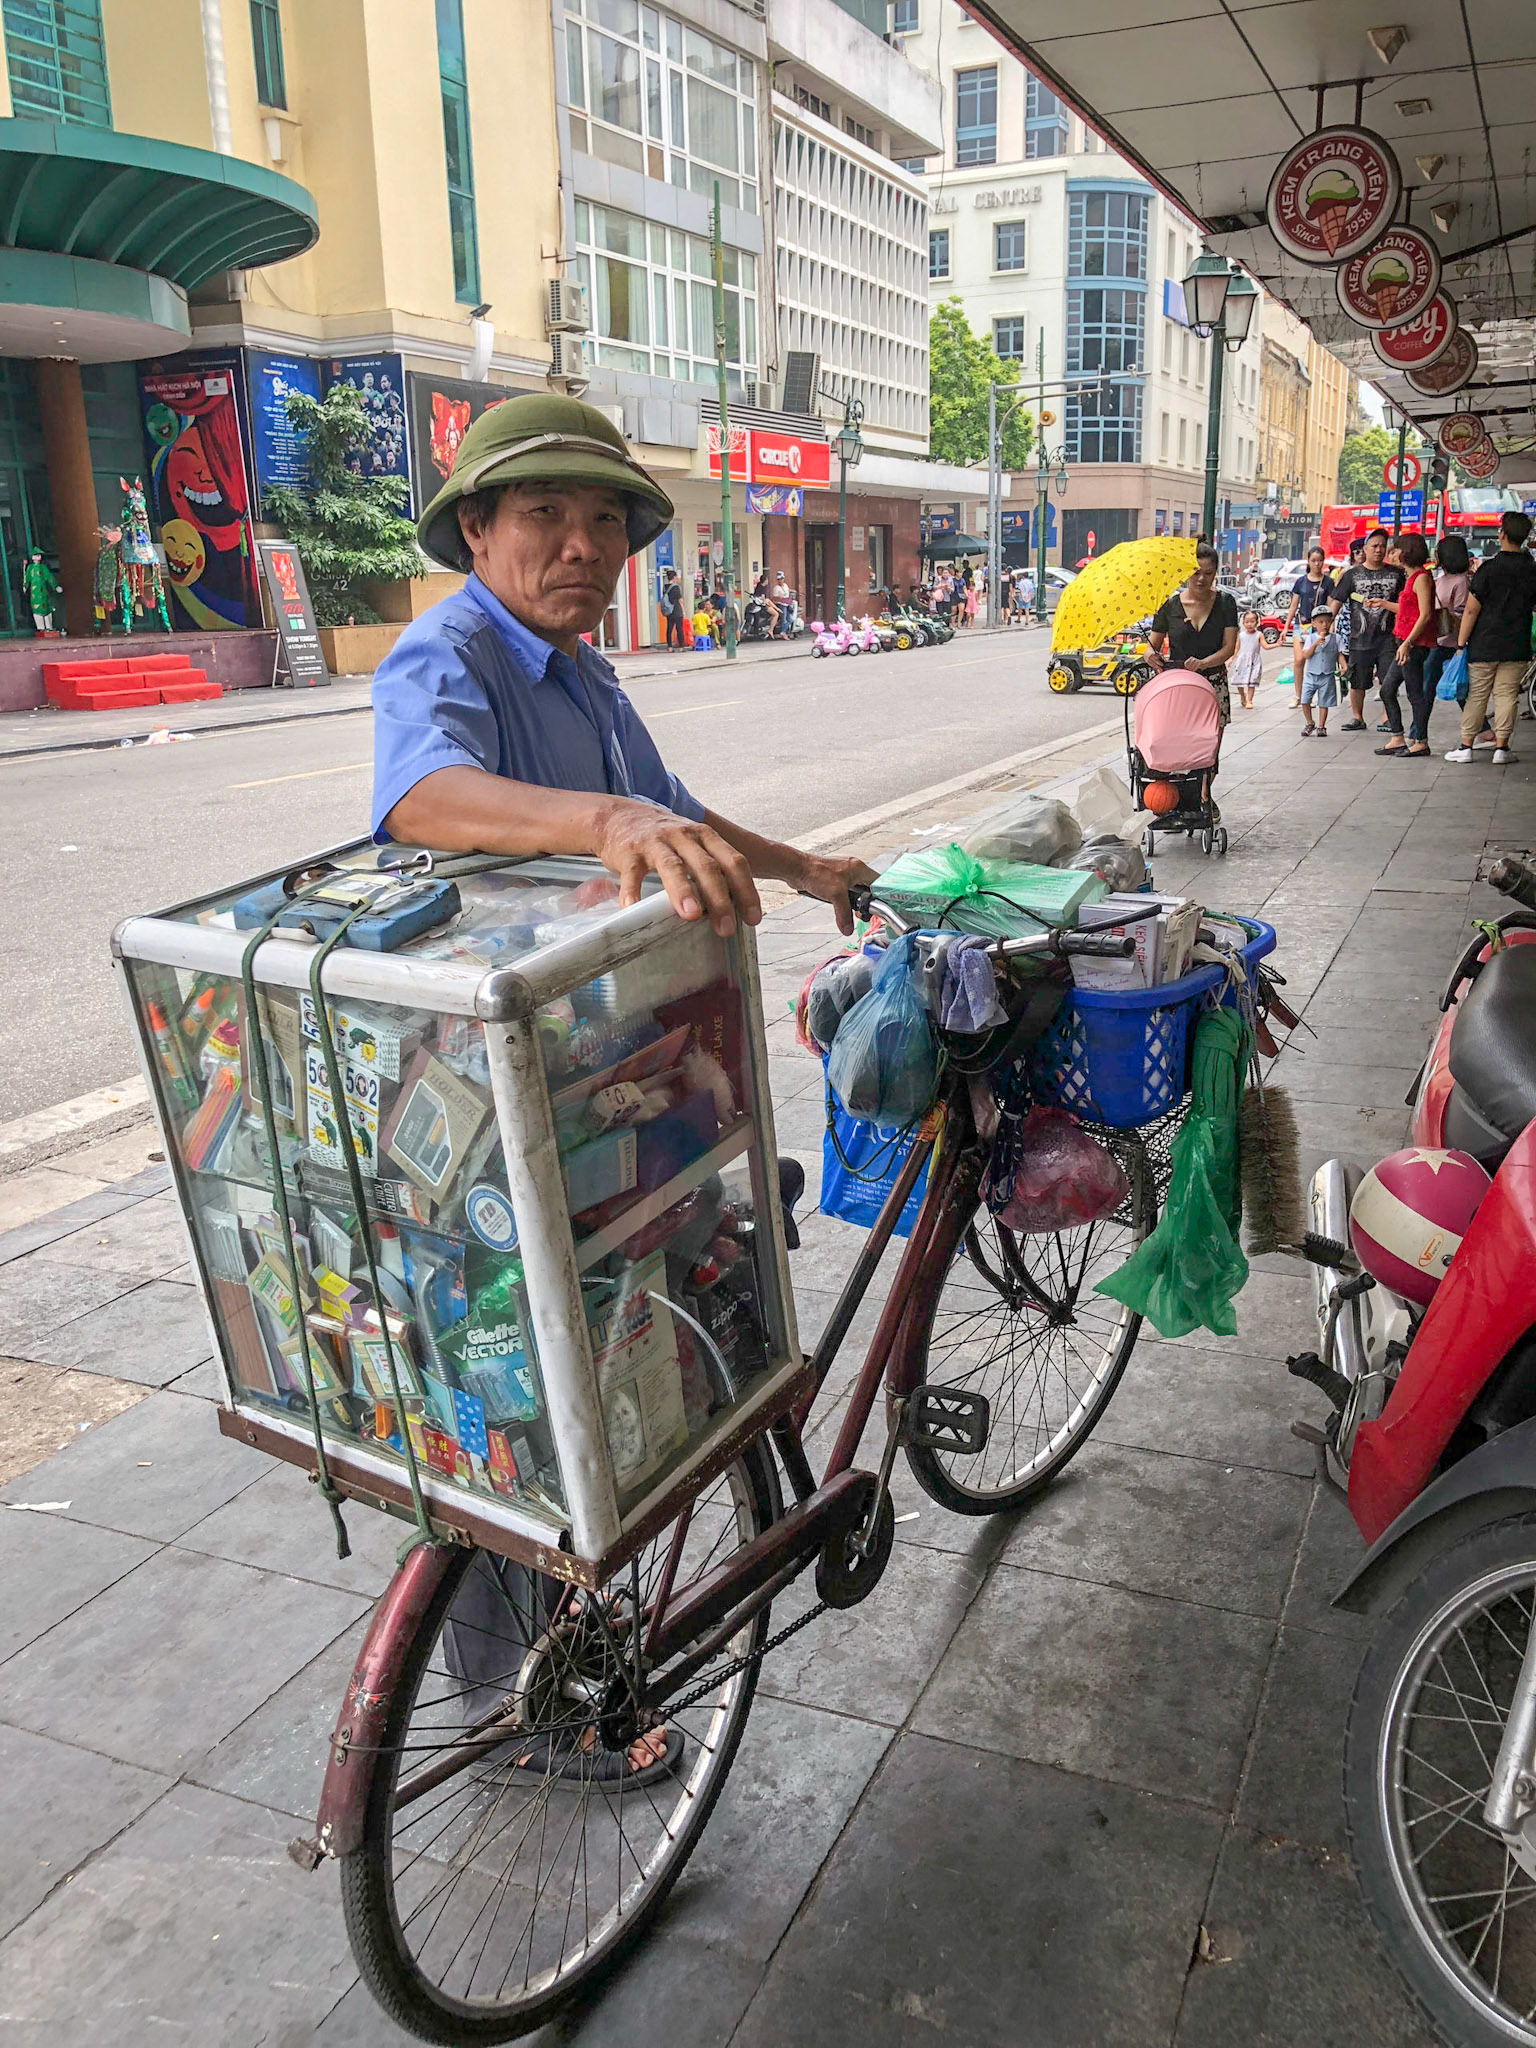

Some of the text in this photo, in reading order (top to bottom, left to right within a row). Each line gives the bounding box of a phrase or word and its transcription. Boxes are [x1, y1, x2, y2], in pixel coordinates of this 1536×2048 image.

[1281, 177, 1299, 220] KEM
[1295, 141, 1363, 172] TRÀNG
[974, 184, 1043, 210] CENTRE
[1291, 208, 1372, 245] Since 1958
[1349, 258, 1364, 293] KEM
[1354, 290, 1418, 315] Since 1958
[1393, 340, 1425, 351] COFFEE
[758, 445, 801, 474] CIRCLE K
[1274, 516, 1313, 524] AZZION
[332, 580, 349, 591] 42
[428, 1069, 477, 1121] HOLDER
[374, 1183, 387, 1207] KNIFE
[383, 1182, 397, 1212] CUTTER
[477, 1201, 497, 1224] TB
[710, 1301, 738, 1330] zippo
[466, 1322, 520, 1345] Gillette
[453, 1337, 523, 1361] VECTOR
